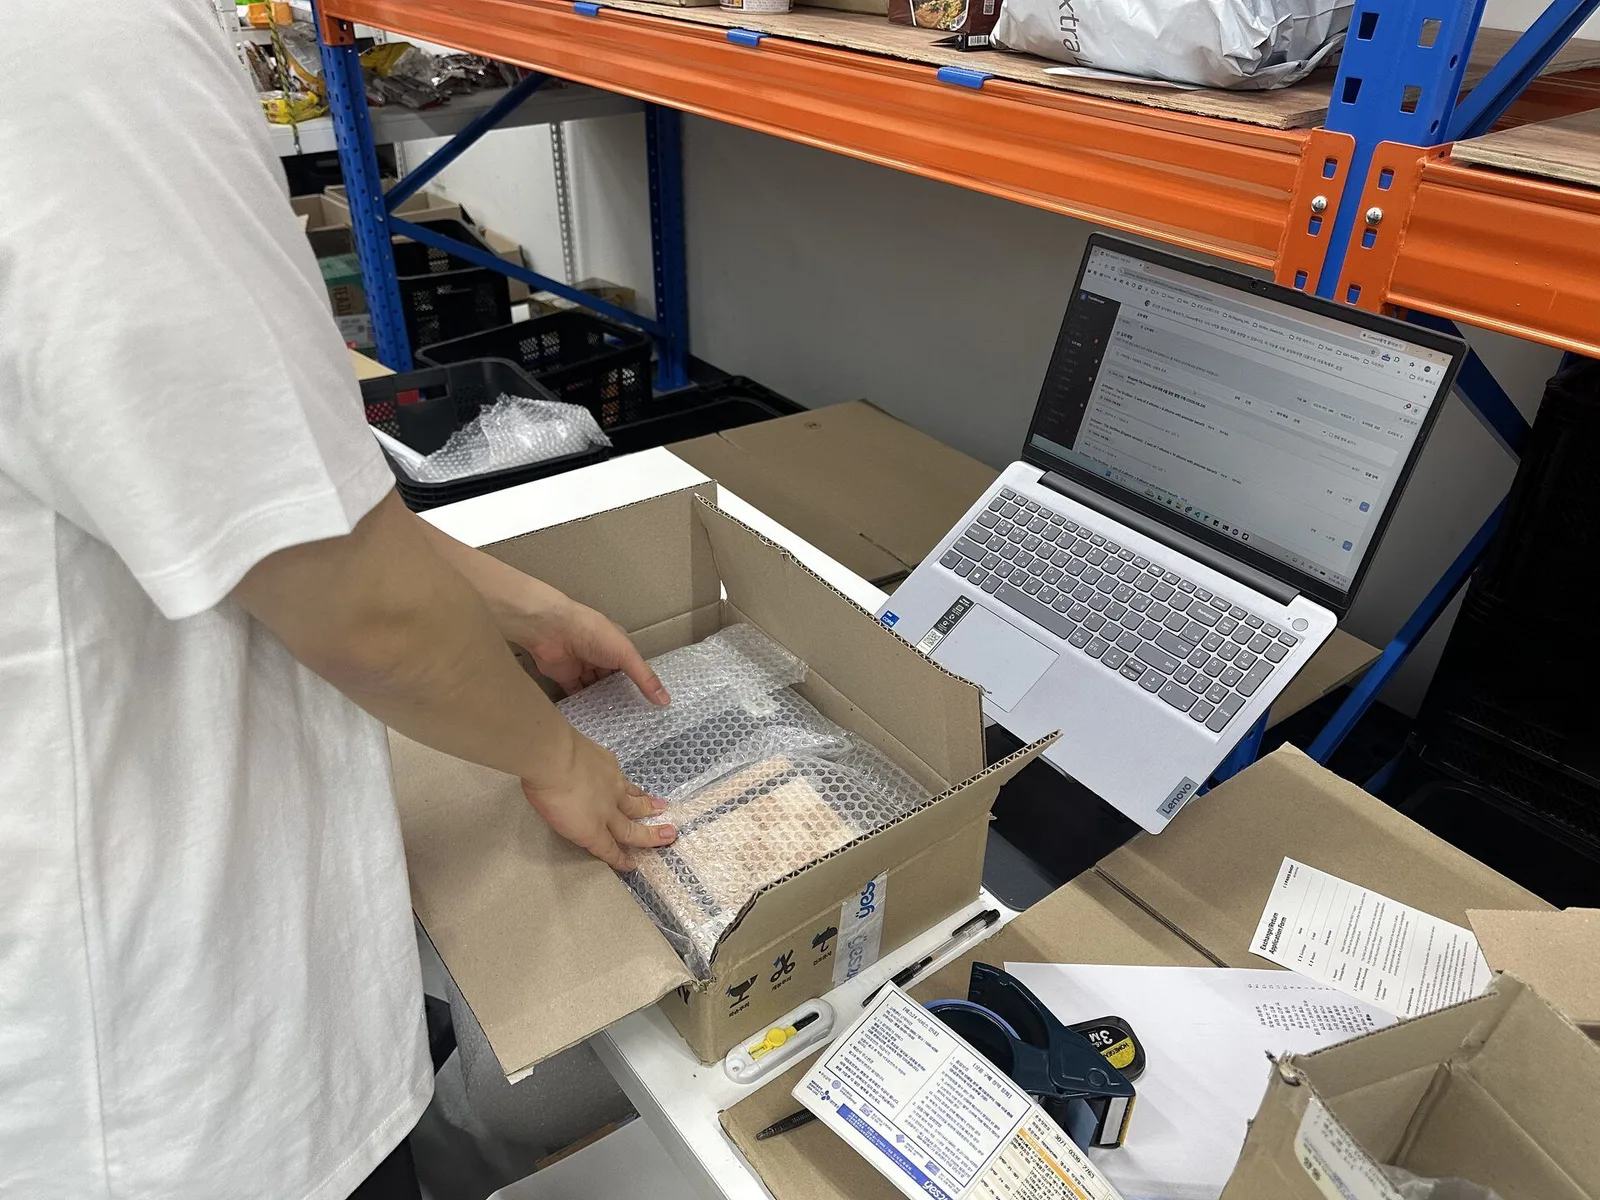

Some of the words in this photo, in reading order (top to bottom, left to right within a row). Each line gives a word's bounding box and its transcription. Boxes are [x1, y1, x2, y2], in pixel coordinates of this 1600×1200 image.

[1162, 783, 1192, 814] Lenovo
[1259, 910, 1280, 951] Exchange/Return
[1267, 926, 1284, 955] Application
[1277, 915, 1287, 929] Form
